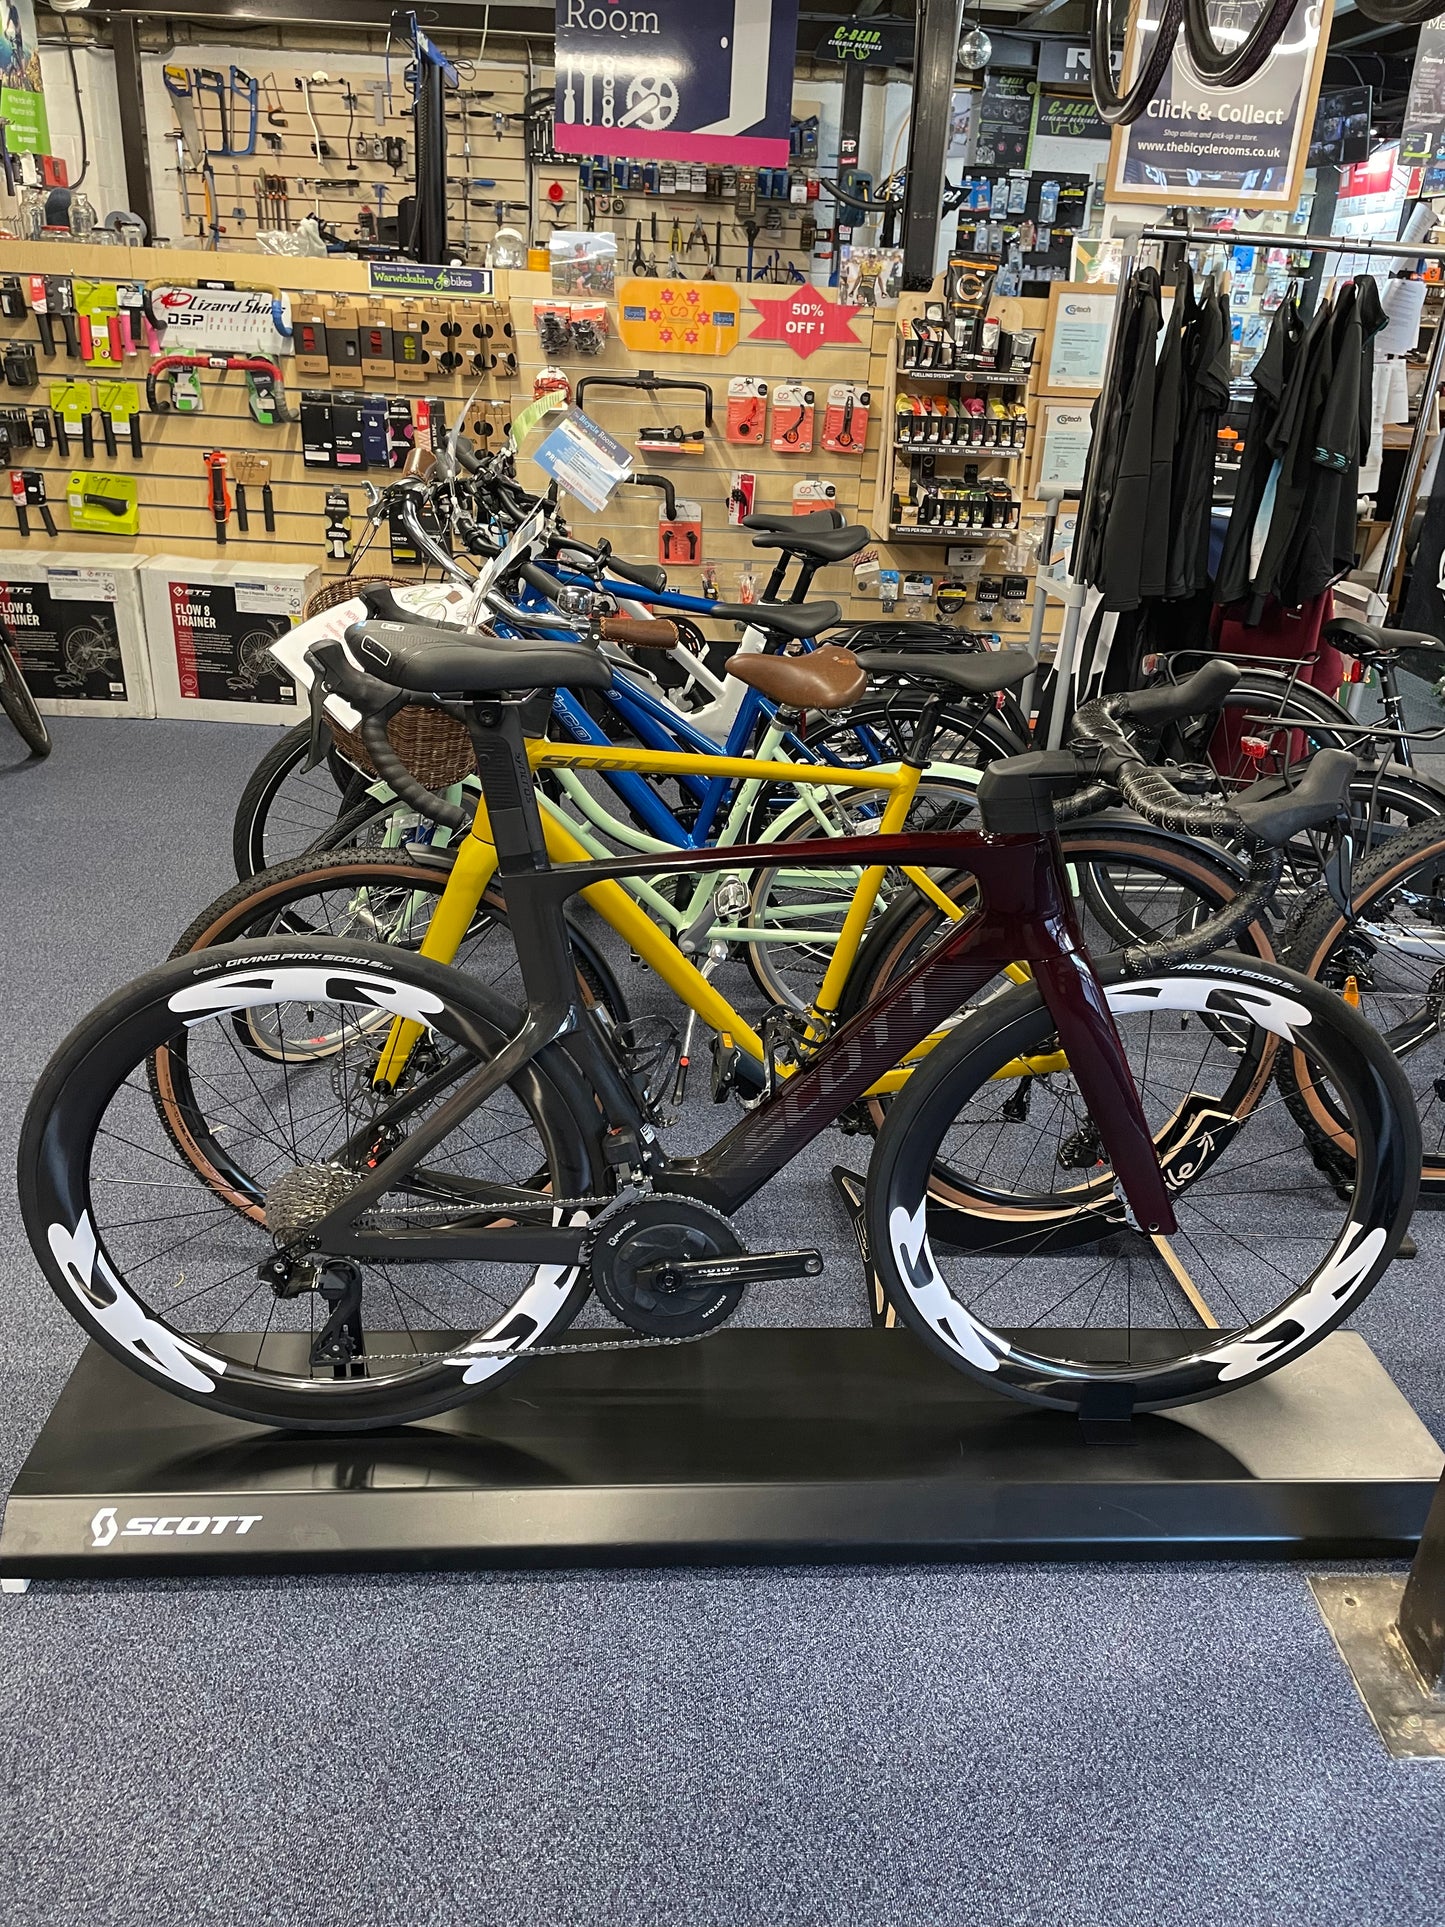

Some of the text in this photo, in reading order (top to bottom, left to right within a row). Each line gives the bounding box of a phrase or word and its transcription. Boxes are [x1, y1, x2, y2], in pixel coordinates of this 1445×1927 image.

[564, 0, 660, 34] Room
[834, 26, 881, 43] C-BEAR
[1048, 101, 1097, 117] C-BEAR
[1146, 99, 1284, 125] Click & Collect
[1163, 128, 1179, 138] Shop
[1179, 129, 1198, 138] online
[1199, 130, 1211, 139] and
[1211, 132, 1234, 141] pick-up
[1241, 134, 1258, 142] store.
[1137, 140, 1281, 158] www.thebicyclerooms.co.uk
[374, 272, 433, 285] Warwickshire
[188, 296, 242, 313] Lizard
[791, 303, 824, 317] 50%
[168, 312, 204, 326] DSP
[785, 321, 825, 335] OFF !
[185, 589, 212, 597] ETC
[26, 603, 33, 614] 8
[174, 602, 211, 617] FLOW 8
[175, 615, 217, 629] TRAINER
[225, 954, 280, 968] GRAND
[280, 953, 322, 961] PRIX
[320, 954, 368, 966] 5000
[1203, 964, 1242, 975] PRIX
[1240, 970, 1282, 986] 5000
[120, 1515, 264, 1536] SCOTT
